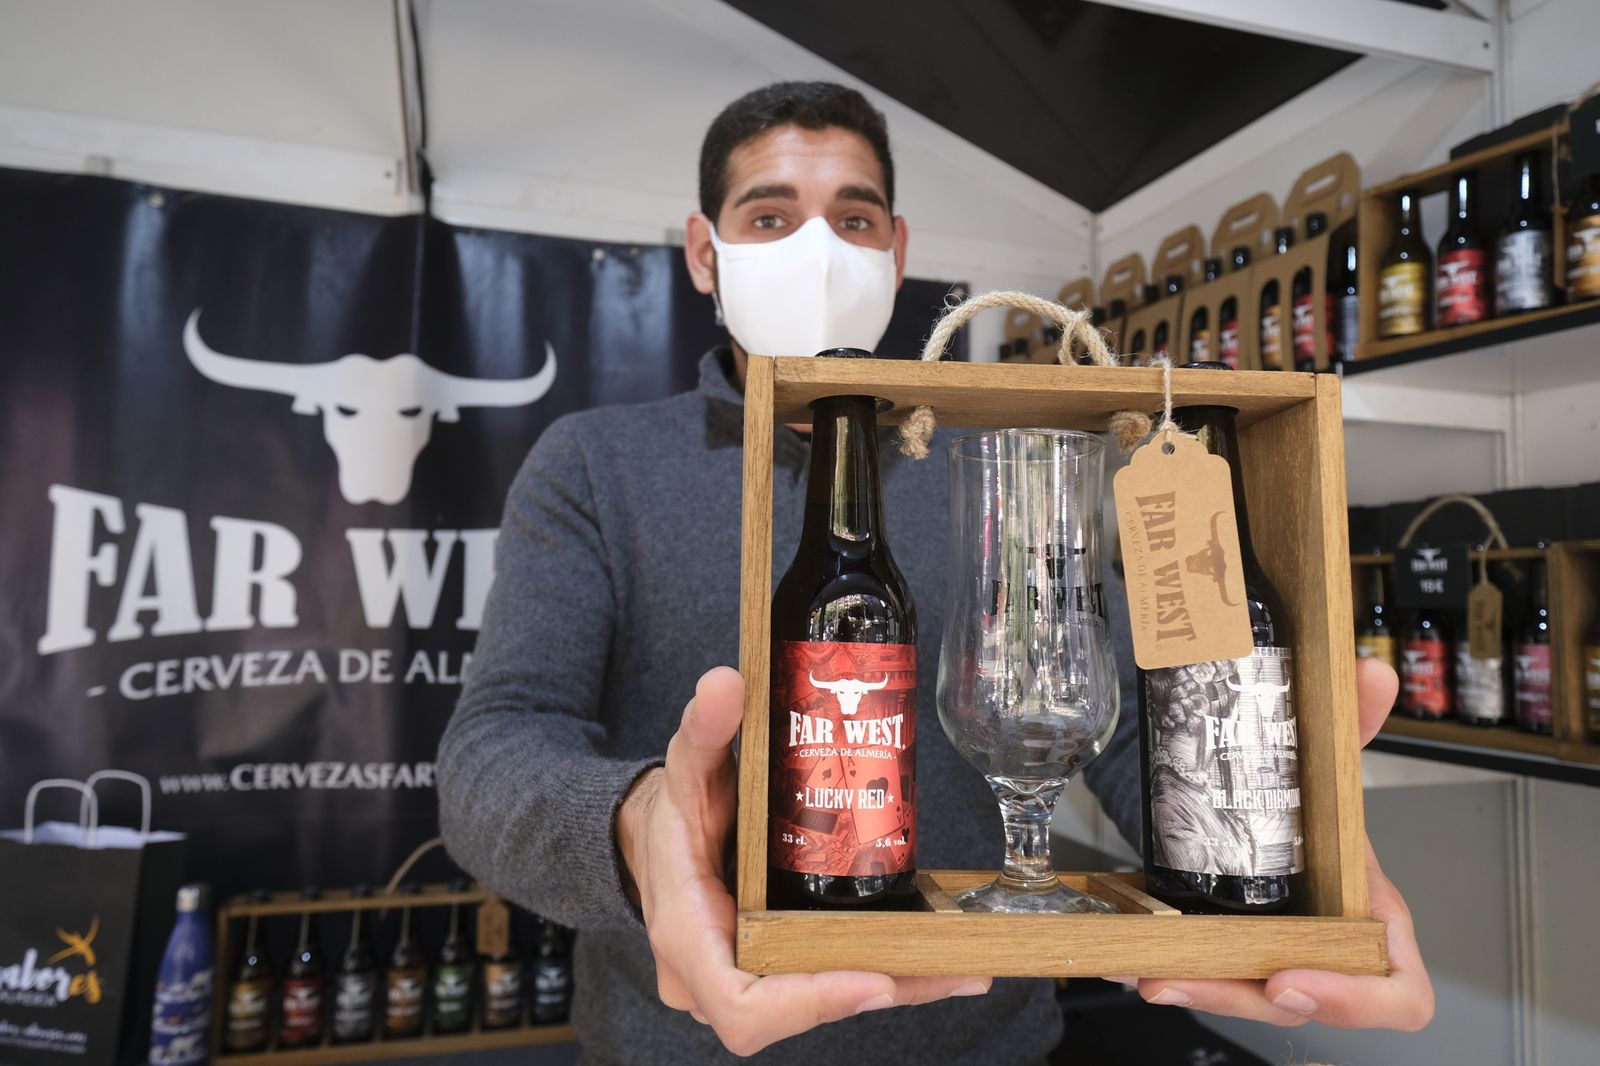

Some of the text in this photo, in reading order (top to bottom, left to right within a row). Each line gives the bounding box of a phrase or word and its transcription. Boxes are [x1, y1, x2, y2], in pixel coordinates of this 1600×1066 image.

[1124, 510, 1145, 561] CERVEZA
[37, 484, 303, 656] FAR
[1135, 490, 1198, 643] FAR WEST
[118, 650, 328, 700] CERVEZA
[338, 649, 394, 684] DE
[789, 710, 904, 749] FAR WEST
[799, 748, 893, 760] CERVEZA DE ALMERÍA
[805, 787, 885, 810] LUCKY RED
[1212, 787, 1263, 810] BLACK
[782, 833, 794, 844] 33
